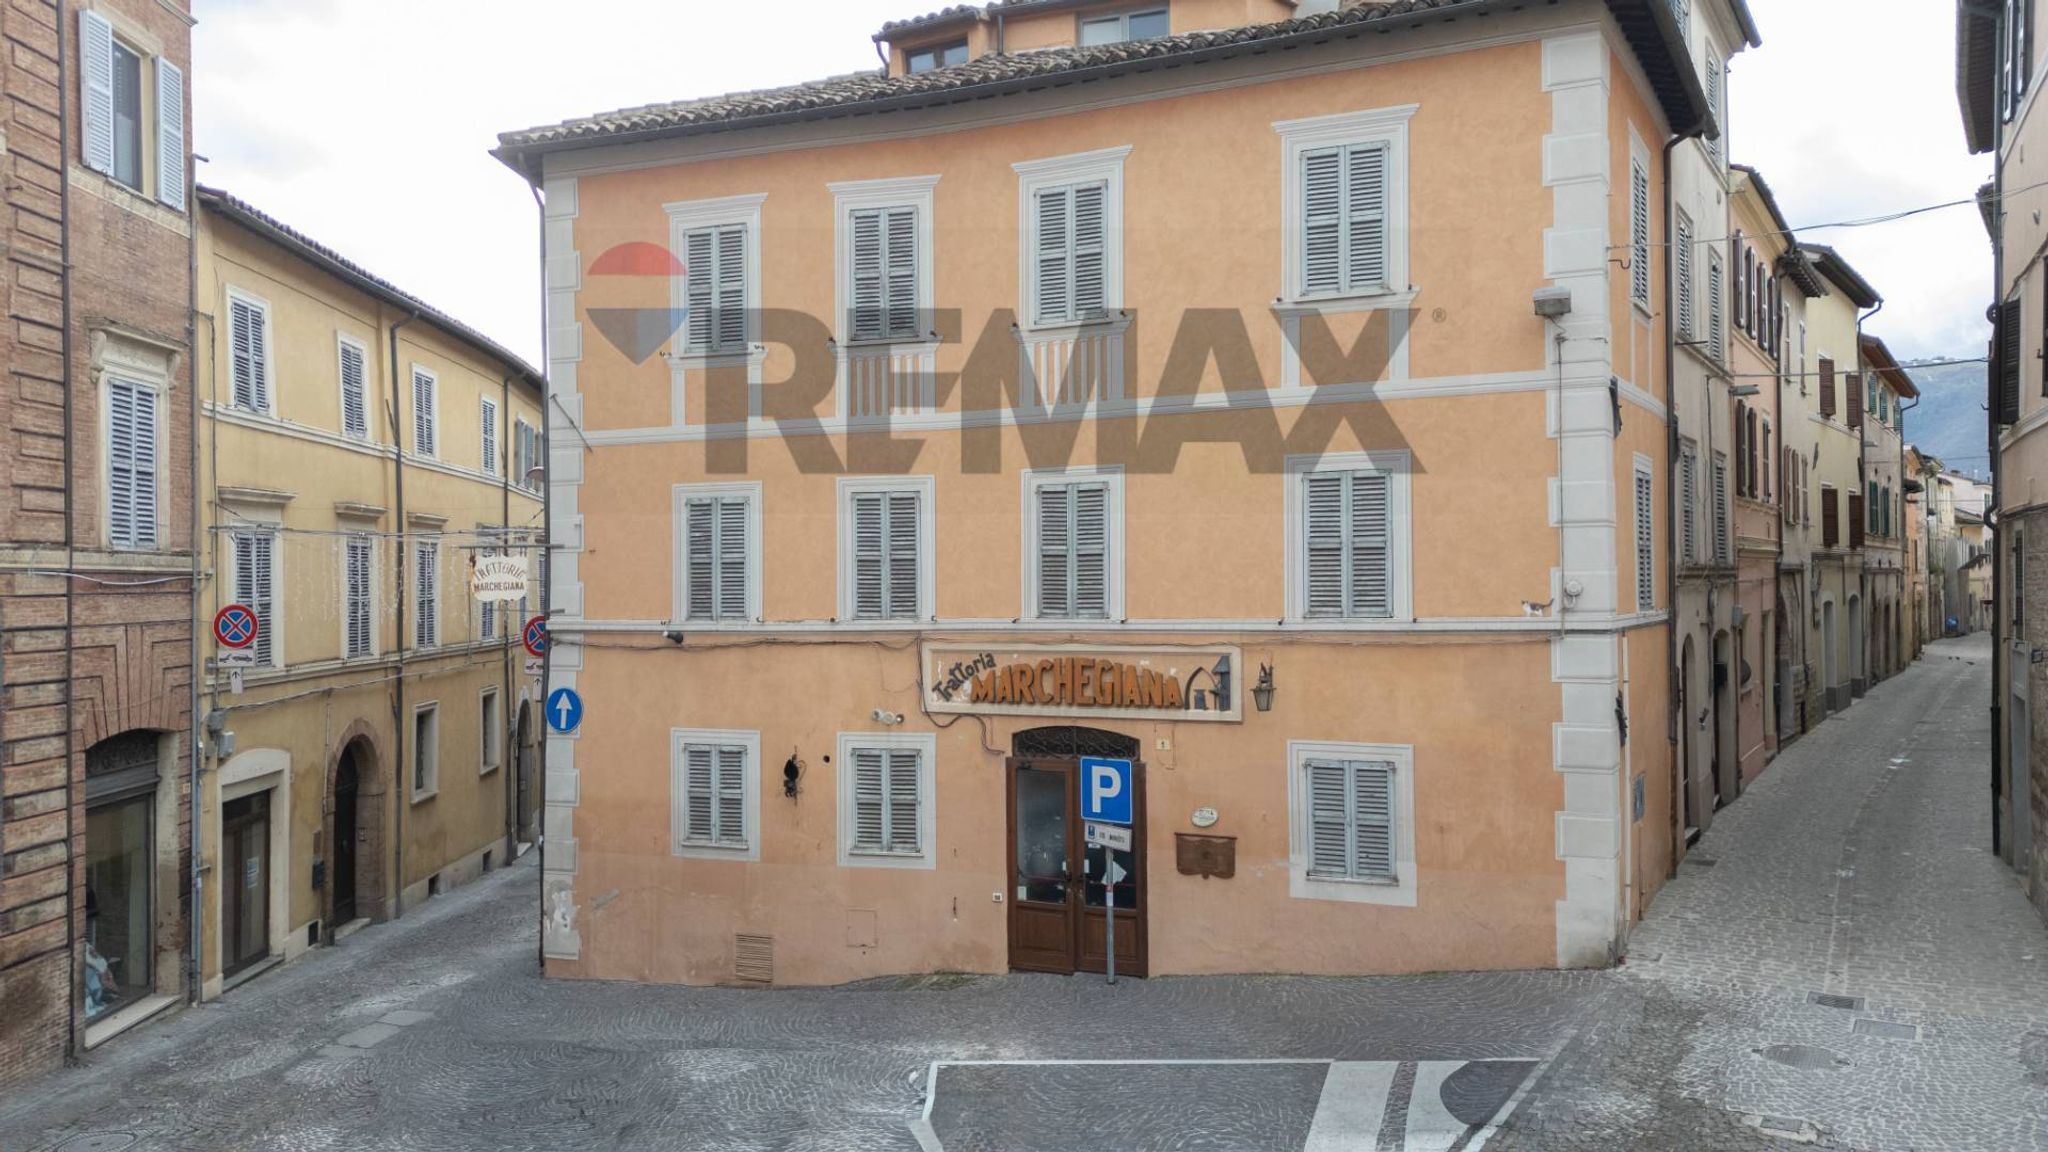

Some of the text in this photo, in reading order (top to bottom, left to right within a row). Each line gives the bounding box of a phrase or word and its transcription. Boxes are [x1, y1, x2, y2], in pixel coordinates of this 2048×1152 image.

[474, 582, 525, 592] MARCHEGIANA
[932, 652, 996, 702] Trattoria
[970, 657, 1184, 709] MARCHEGIANA
[1091, 765, 1121, 813] P
